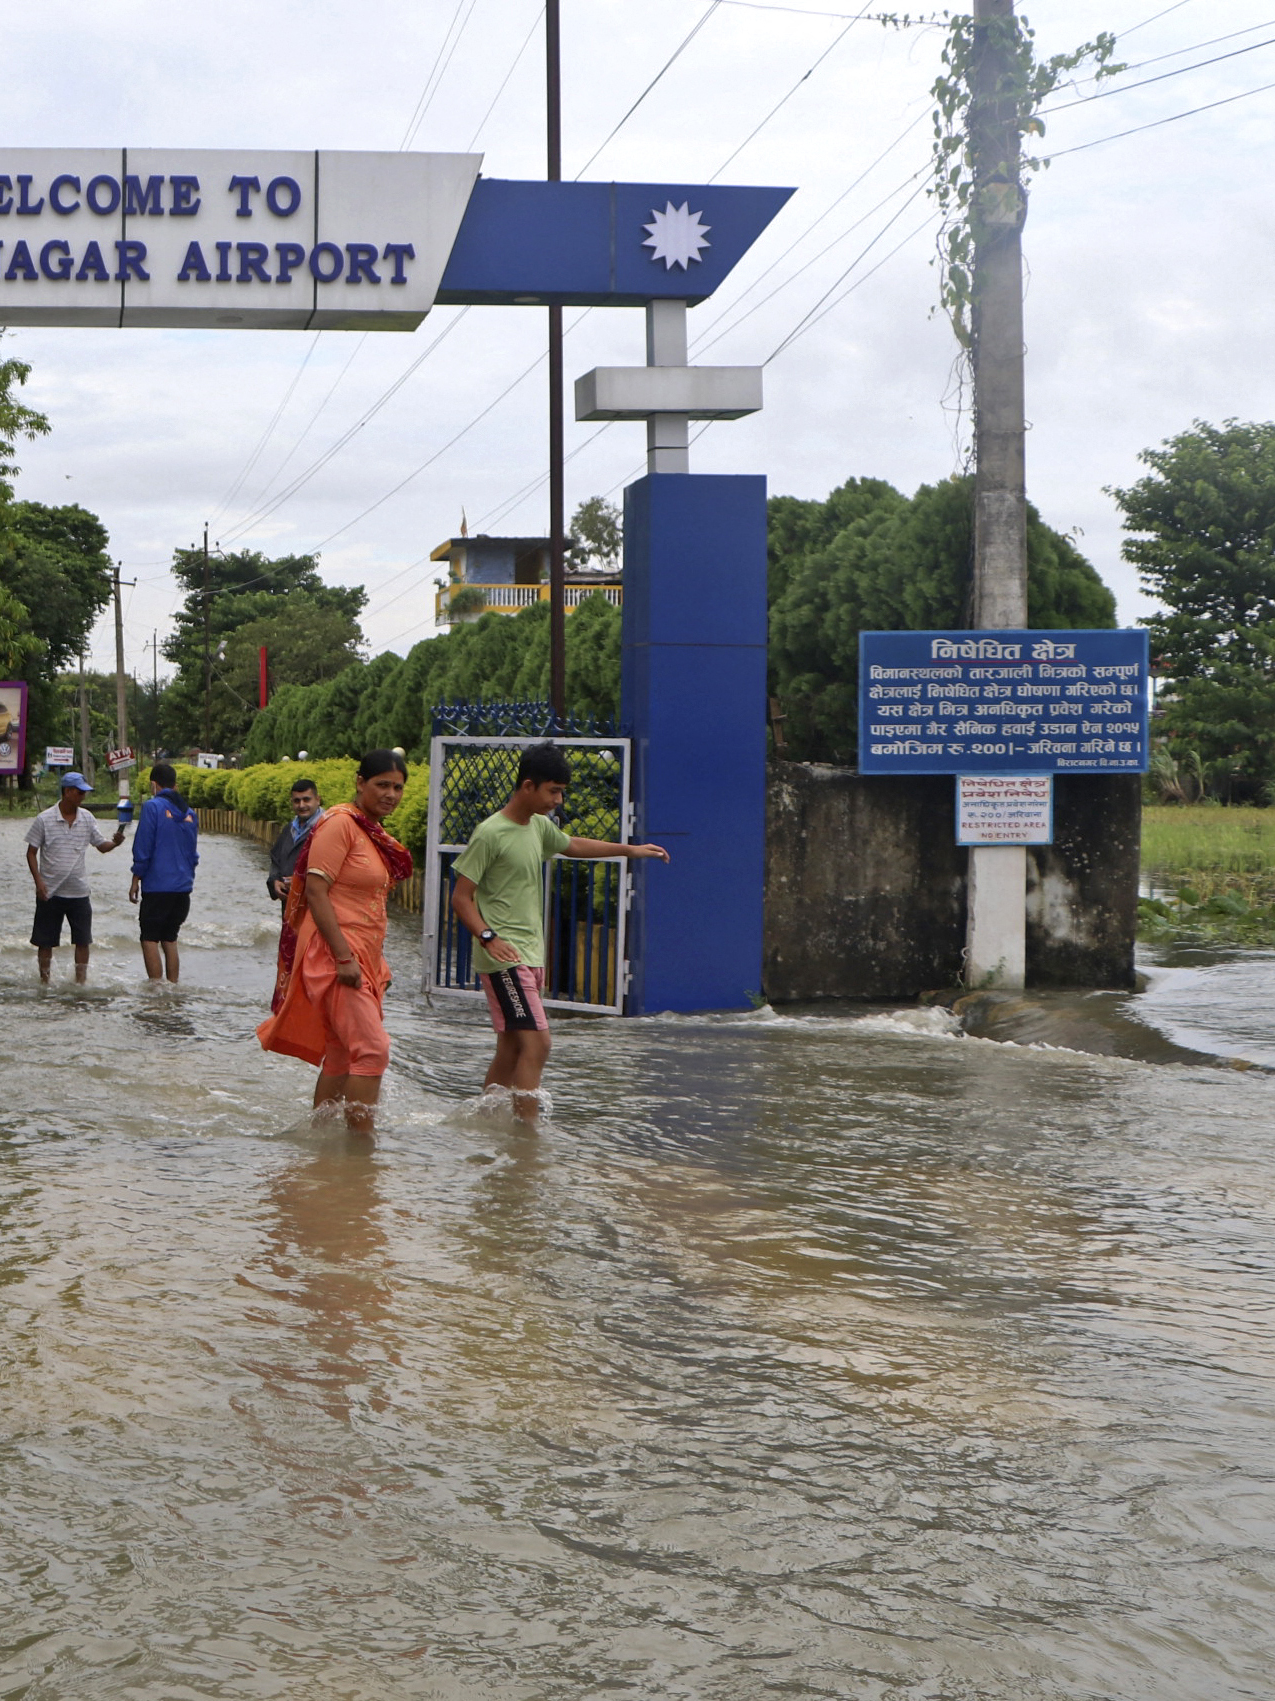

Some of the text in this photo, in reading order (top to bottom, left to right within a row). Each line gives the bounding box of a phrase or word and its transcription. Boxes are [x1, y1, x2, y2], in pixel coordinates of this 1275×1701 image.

[229, 176, 301, 217] TO
[178, 241, 416, 285] AIRPORT
[931, 638, 1077, 660] निषेधित क्षेत्र
[870, 664, 963, 680] विमानस्थलको
[969, 663, 1033, 680] तारजाली
[1039, 663, 1087, 679] भित्रको
[869, 683, 922, 699] क्षेत्रलाई
[927, 682, 980, 698] निषेधित
[983, 682, 1012, 698] क्षेत्र
[1017, 682, 1062, 697] घोषणा
[1065, 681, 1117, 697] गरिएको
[877, 699, 1133, 719] यस क्षेत्र भित्र अनधिकृत प्रवेश गरेको
[870, 720, 1140, 738] पाइएमा गैर सैनिक हवाई उडान ऐन २०१५
[109, 747, 132, 761] ATM
[870, 739, 944, 755] बमोजिम
[1080, 738, 1116, 754] गरिने
[961, 778, 1016, 788] निषेधित
